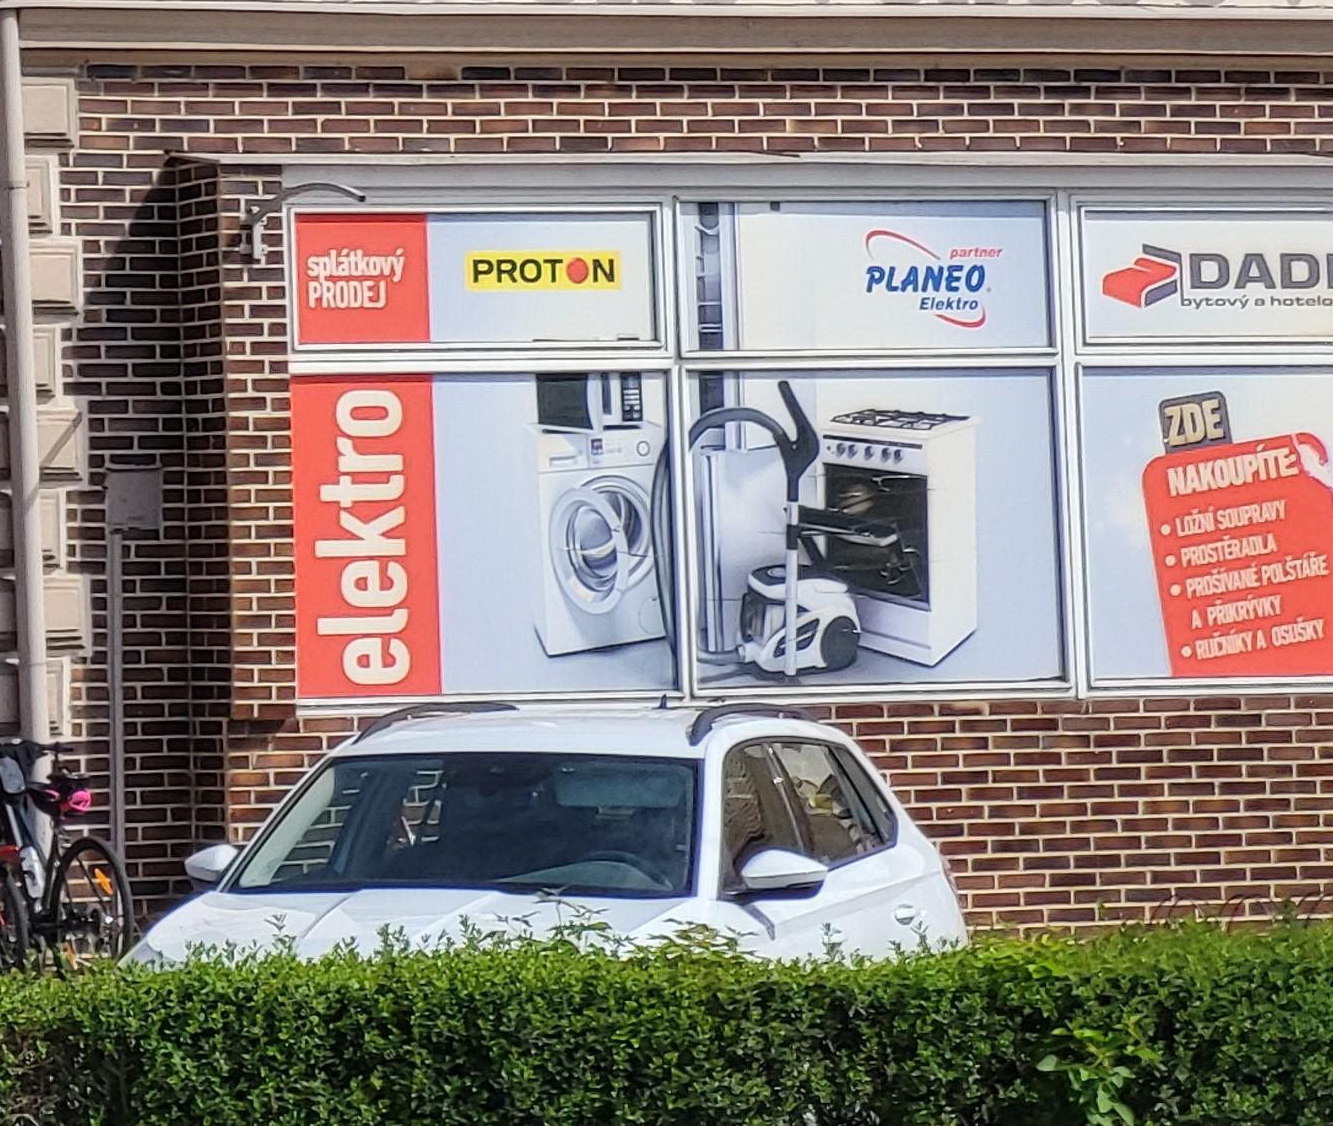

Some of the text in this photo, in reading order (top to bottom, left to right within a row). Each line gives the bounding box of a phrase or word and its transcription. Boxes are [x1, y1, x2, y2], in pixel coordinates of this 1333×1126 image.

[306, 247, 404, 282] splátkový
[949, 247, 1003, 260] partner
[307, 280, 387, 309] PRODEJ
[866, 264, 986, 293] PLANEO
[919, 297, 979, 311] Elektro
[1180, 294, 1249, 309] bytový
[1254, 297, 1265, 307] a
[1164, 398, 1225, 447] ZDE
[1175, 499, 1286, 537] LOŽNÍ SOUPRAVY
[314, 387, 411, 686] elektro
[1180, 533, 1277, 568] PROSTĚRADLA
[1185, 551, 1329, 599] PROŠÍVANÉ POLŠTÁŘE
[1191, 594, 1282, 629] A PŘIKRÝVKY
[1195, 617, 1325, 660] RUČNÍKY A OSUŠKY
